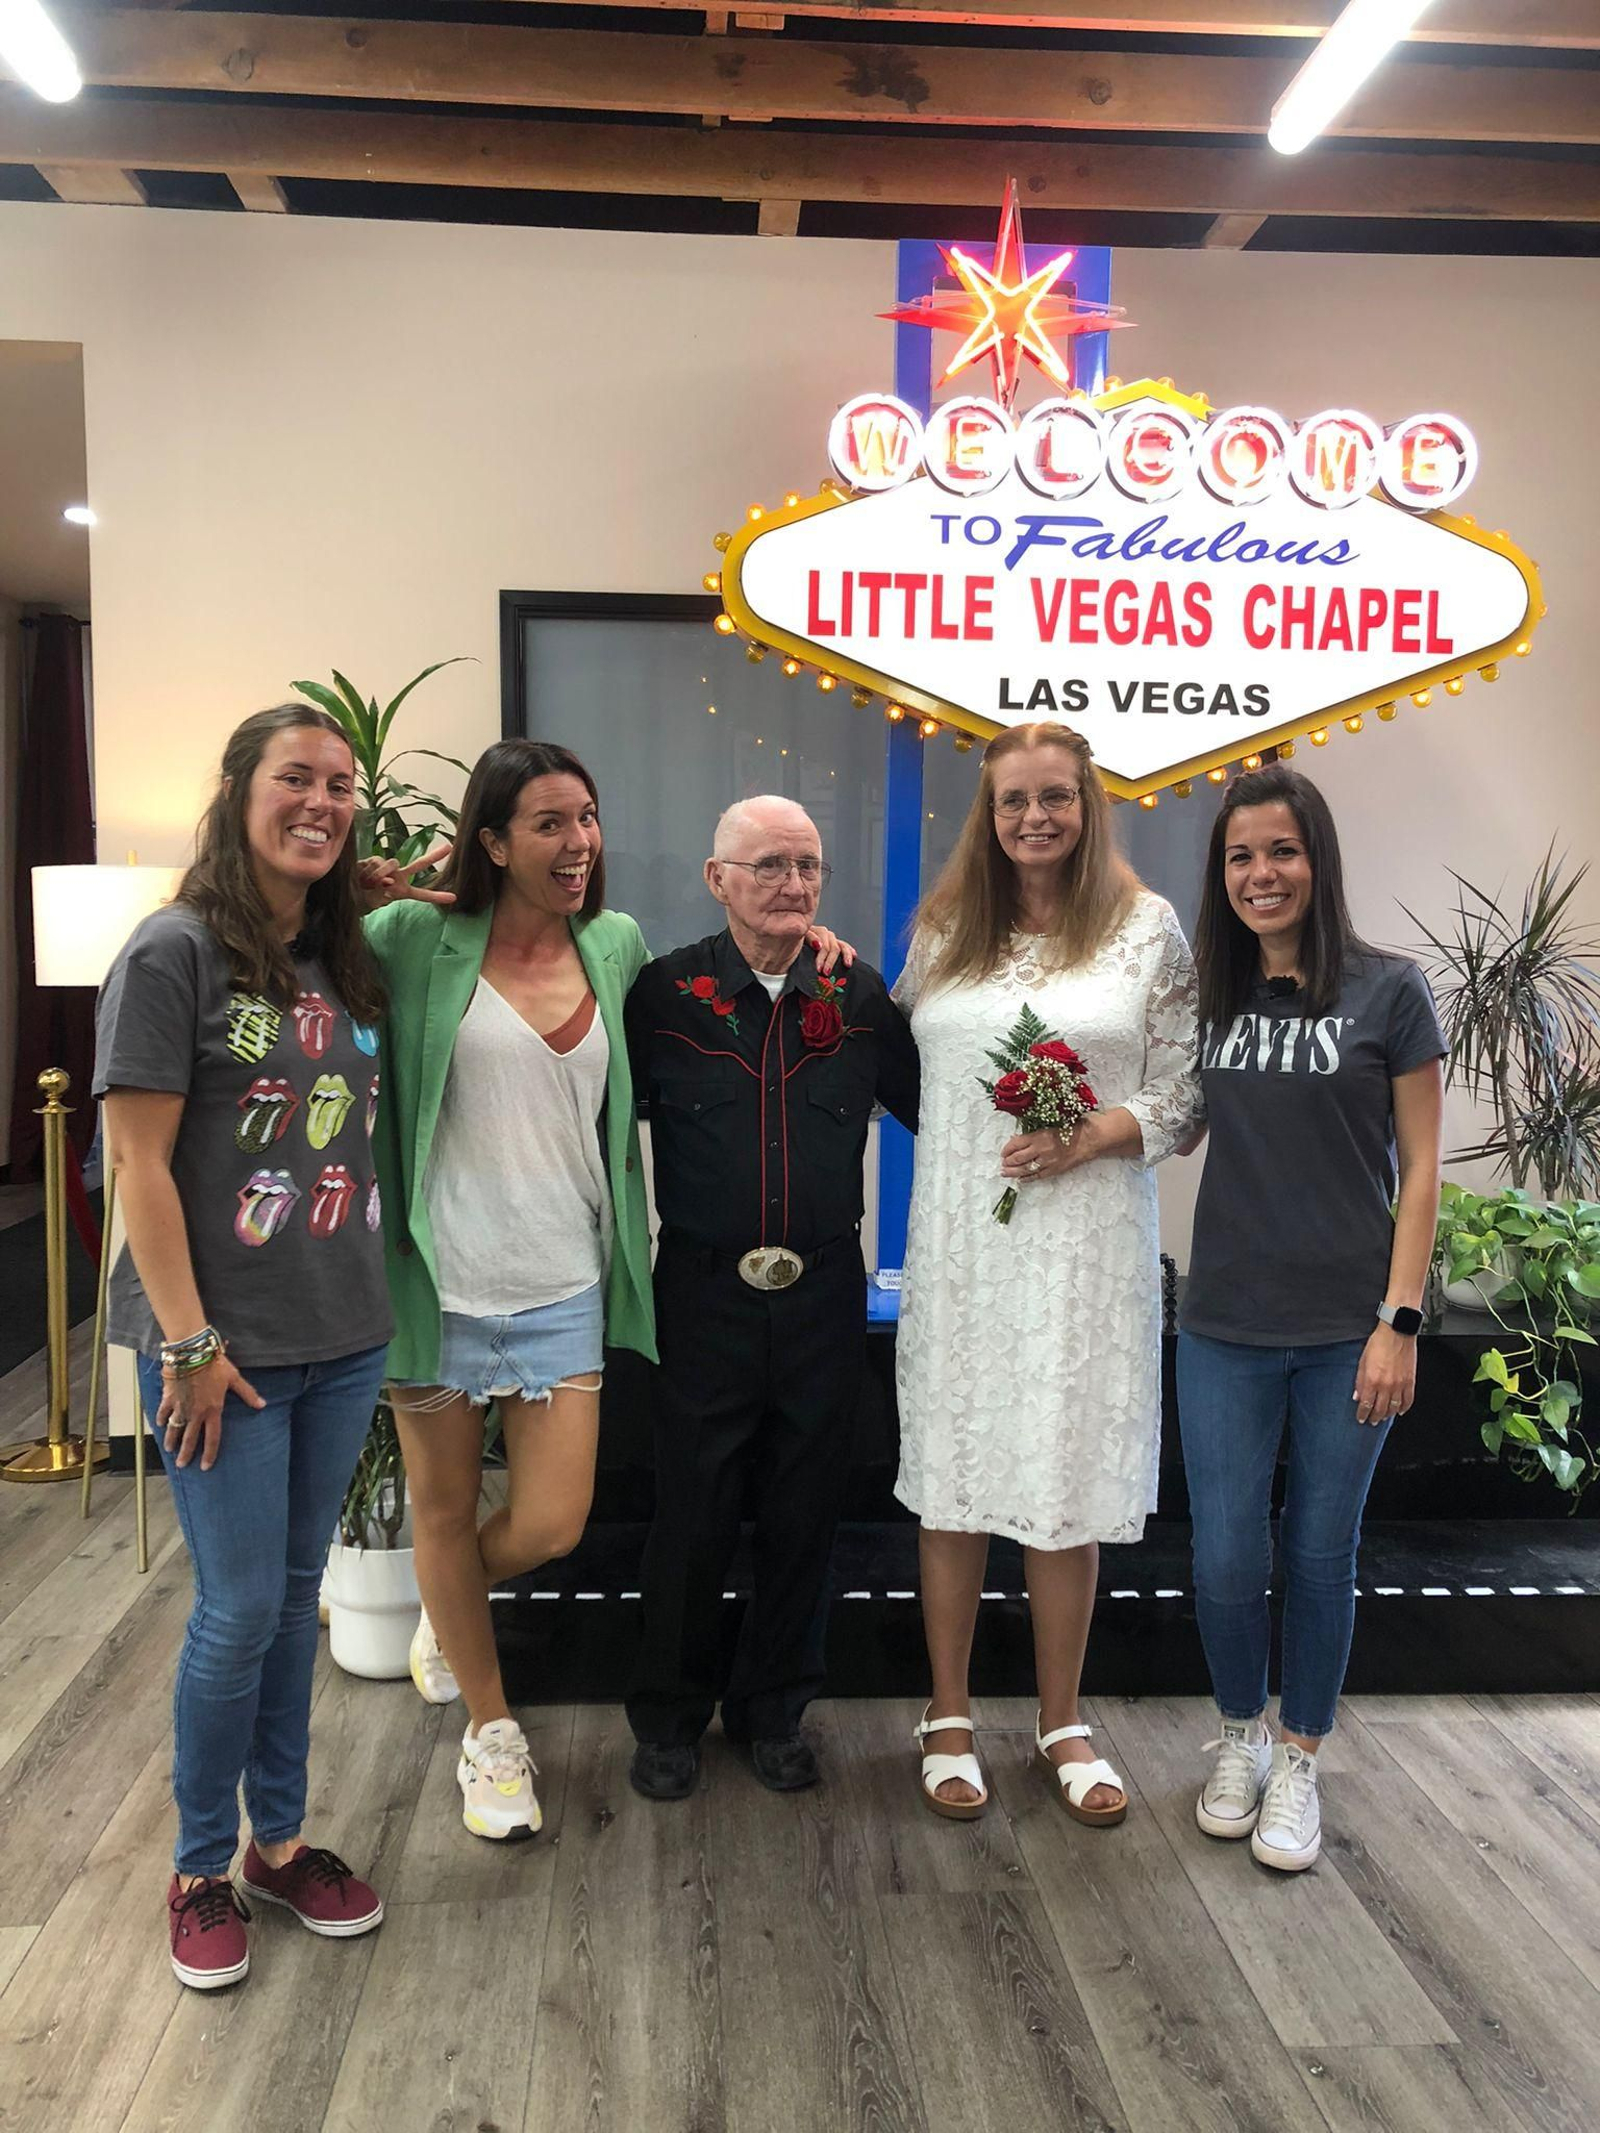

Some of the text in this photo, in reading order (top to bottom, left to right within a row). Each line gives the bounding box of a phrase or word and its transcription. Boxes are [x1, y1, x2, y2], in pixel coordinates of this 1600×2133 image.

[844, 408, 1446, 497] WELCOME
[931, 514, 1360, 571] TO Fabulous
[807, 569, 1454, 655] LITTLE VEGAS CHAPEL
[998, 677, 1271, 717] LAS VEGAS
